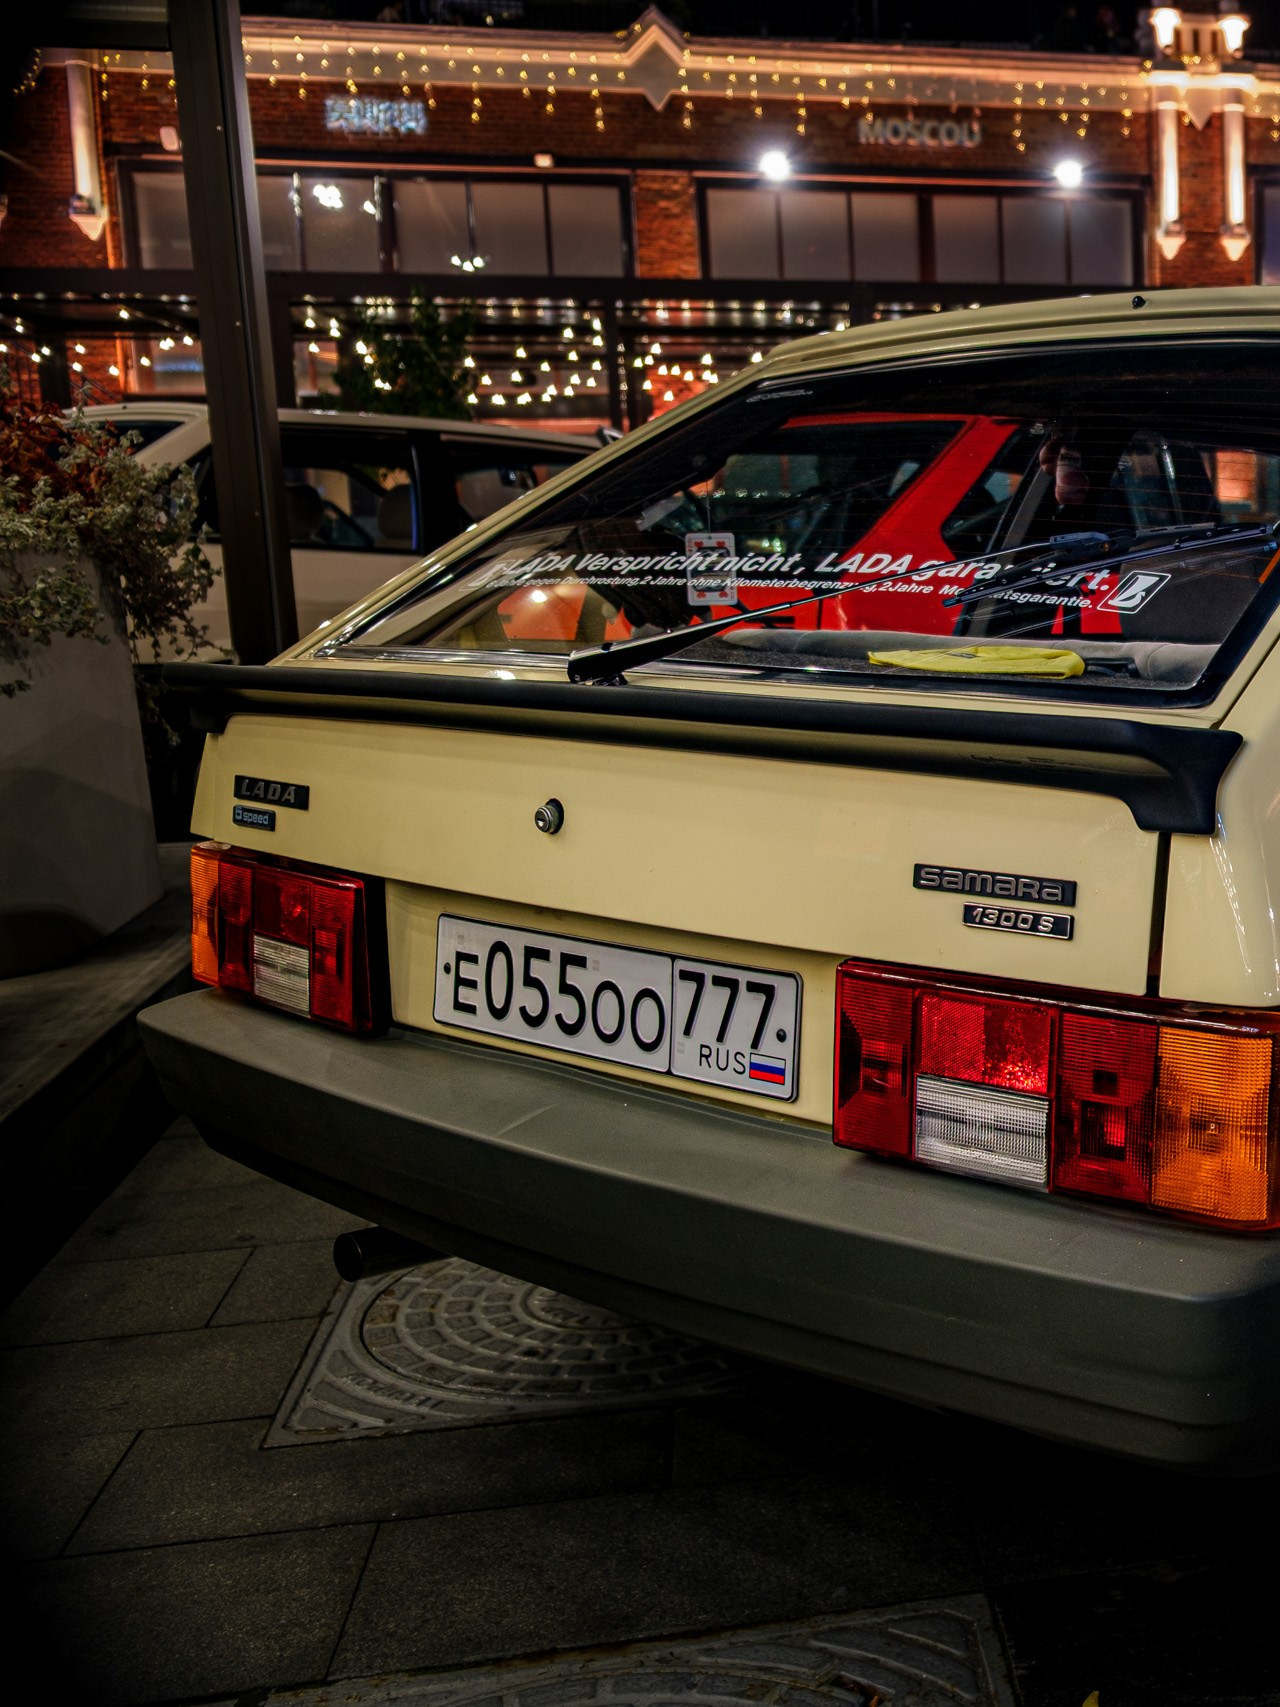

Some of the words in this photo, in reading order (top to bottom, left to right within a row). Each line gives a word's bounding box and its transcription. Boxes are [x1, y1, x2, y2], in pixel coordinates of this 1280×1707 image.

[858, 118, 982, 148] MOSCOU
[502, 554, 577, 575] LADA
[574, 551, 720, 575] Verspricht
[814, 552, 914, 574] LADA
[687, 576, 722, 587] ohne
[240, 778, 297, 803] LADA
[242, 811, 269, 825] speed
[973, 907, 1033, 930] 1300
[1037, 916, 1055, 932] S
[678, 969, 777, 1050] 777
[699, 1044, 747, 1076] RUS
